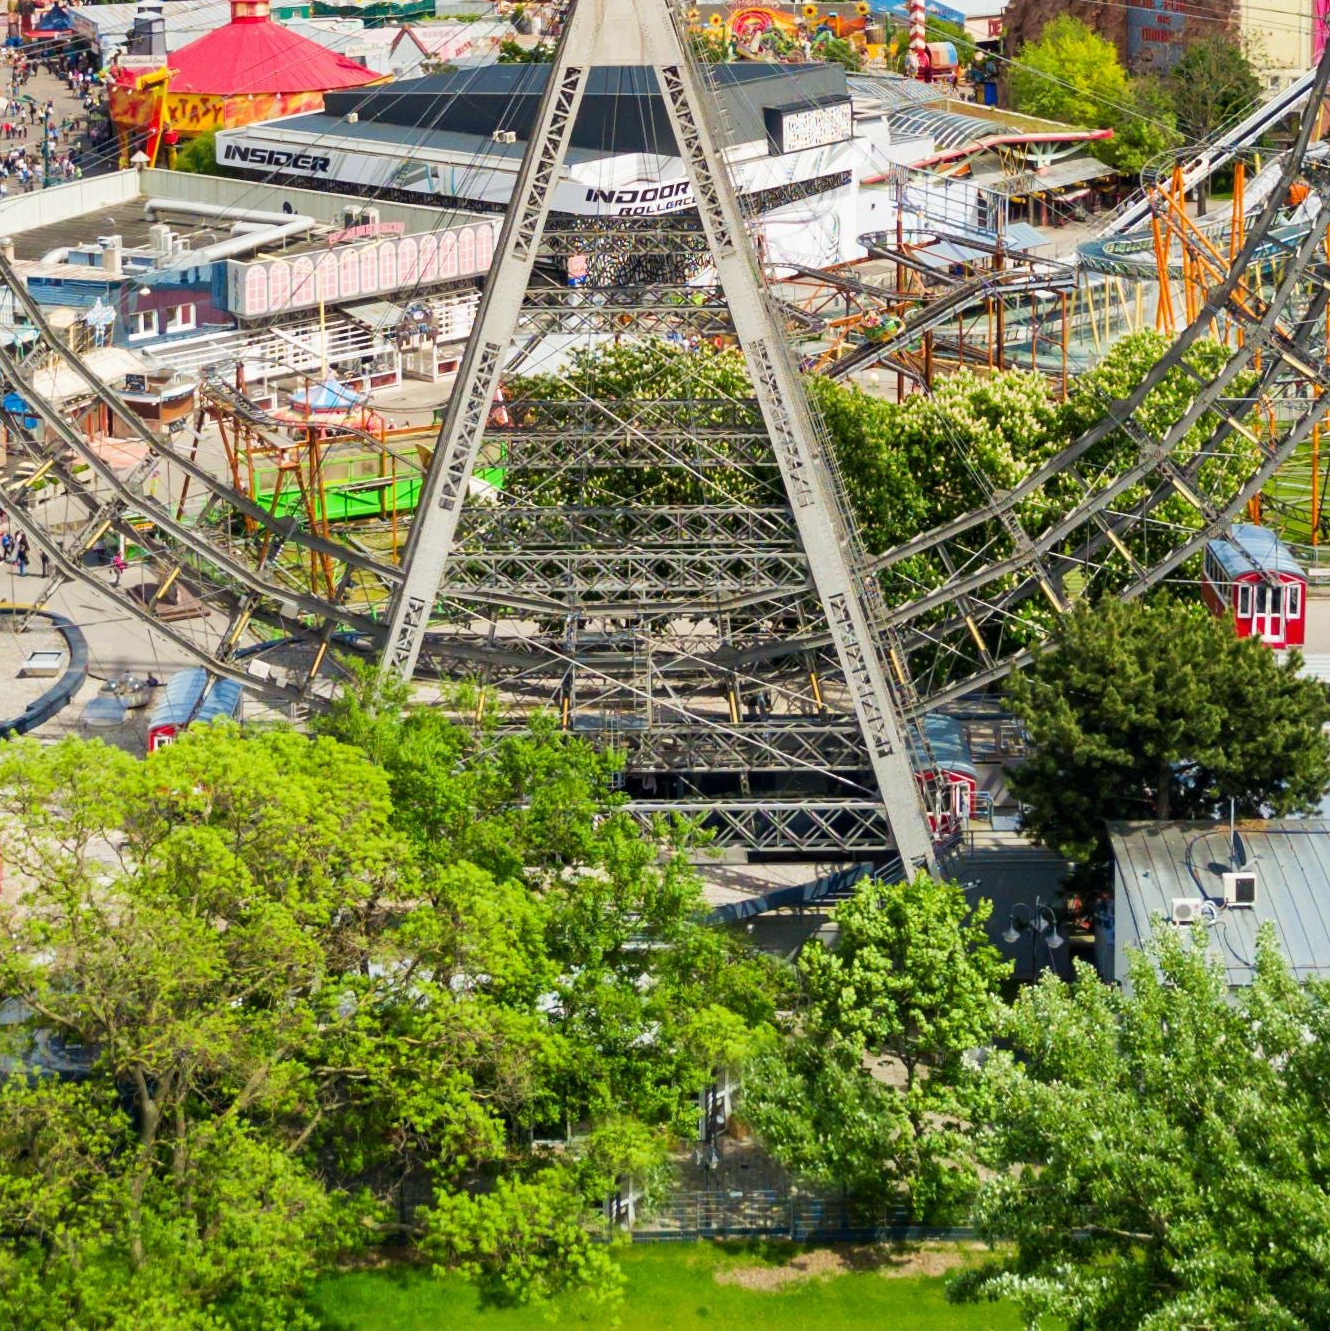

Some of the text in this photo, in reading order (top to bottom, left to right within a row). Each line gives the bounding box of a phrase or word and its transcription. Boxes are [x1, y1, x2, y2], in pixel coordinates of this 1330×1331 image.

[168, 96, 223, 125] XTASY
[223, 144, 331, 173] INSIDER
[585, 180, 690, 205] INDOOR
